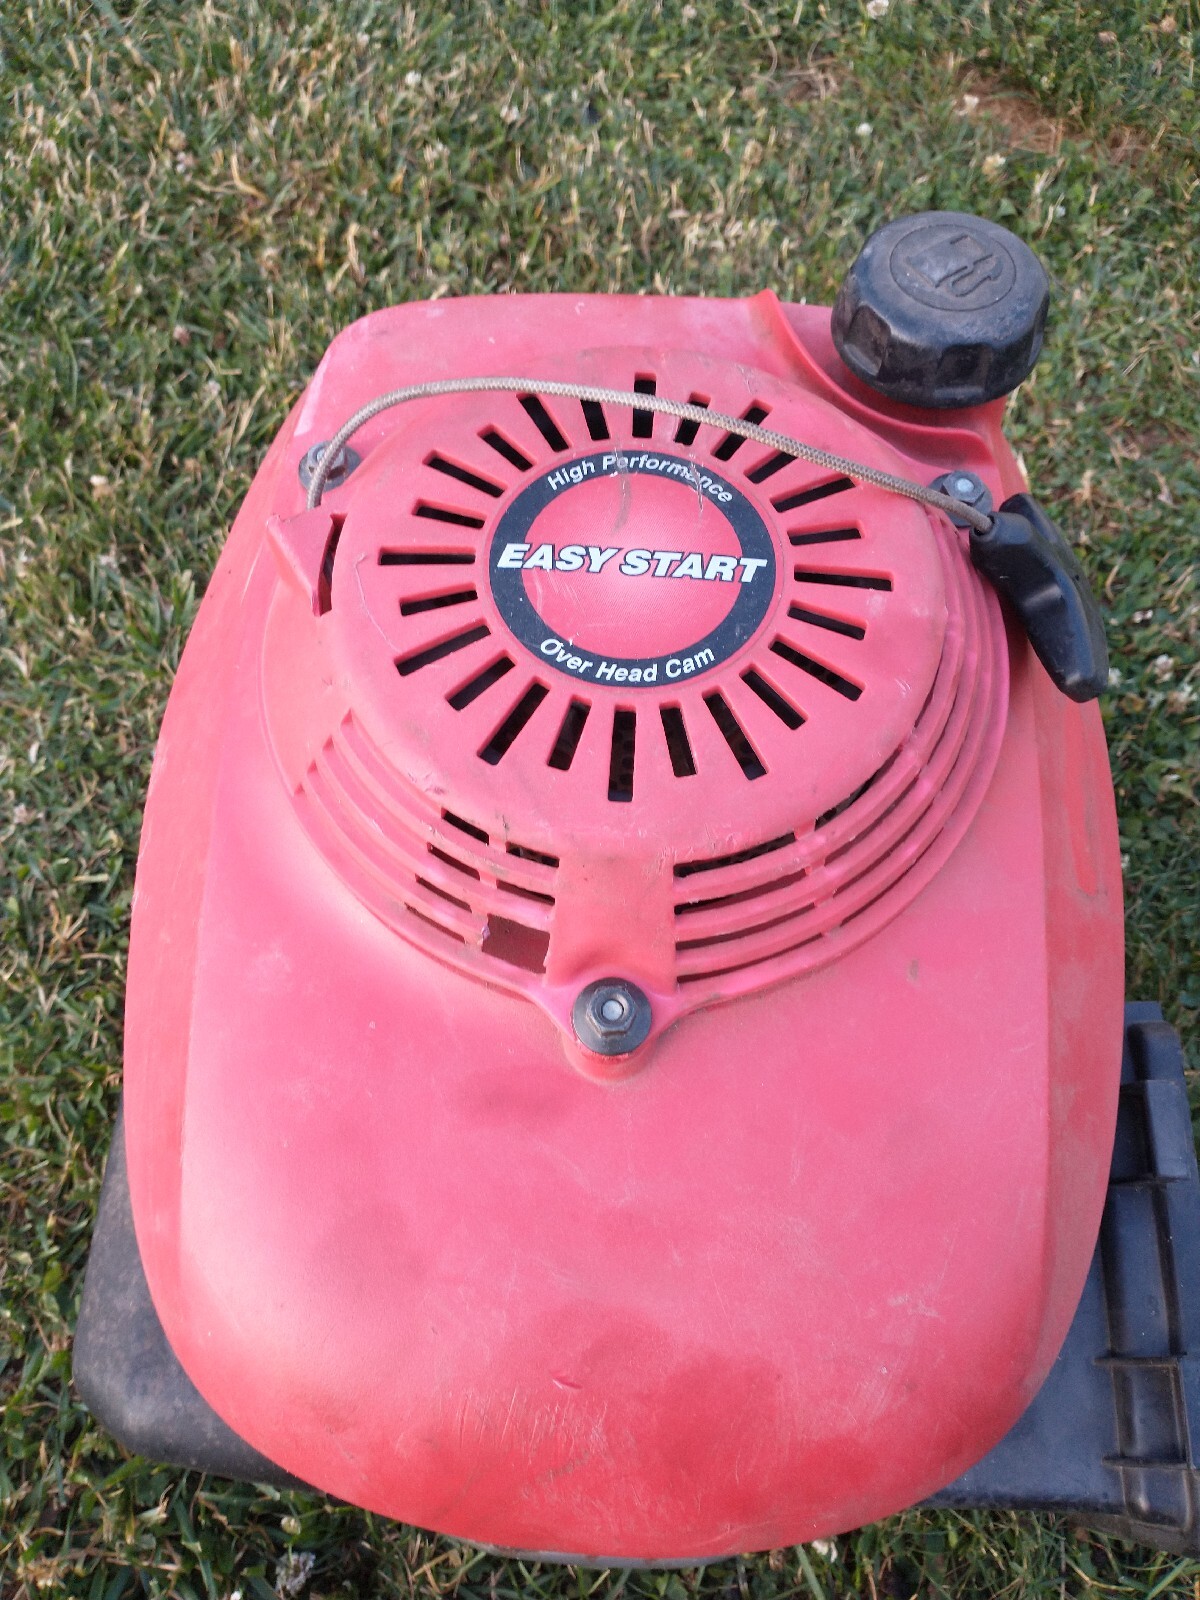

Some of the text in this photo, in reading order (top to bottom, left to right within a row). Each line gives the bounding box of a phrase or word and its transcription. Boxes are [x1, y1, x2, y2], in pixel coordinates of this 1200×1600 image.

[547, 460, 596, 491] High
[496, 543, 768, 583] EASY START
[540, 638, 715, 682] Over Head Cam
